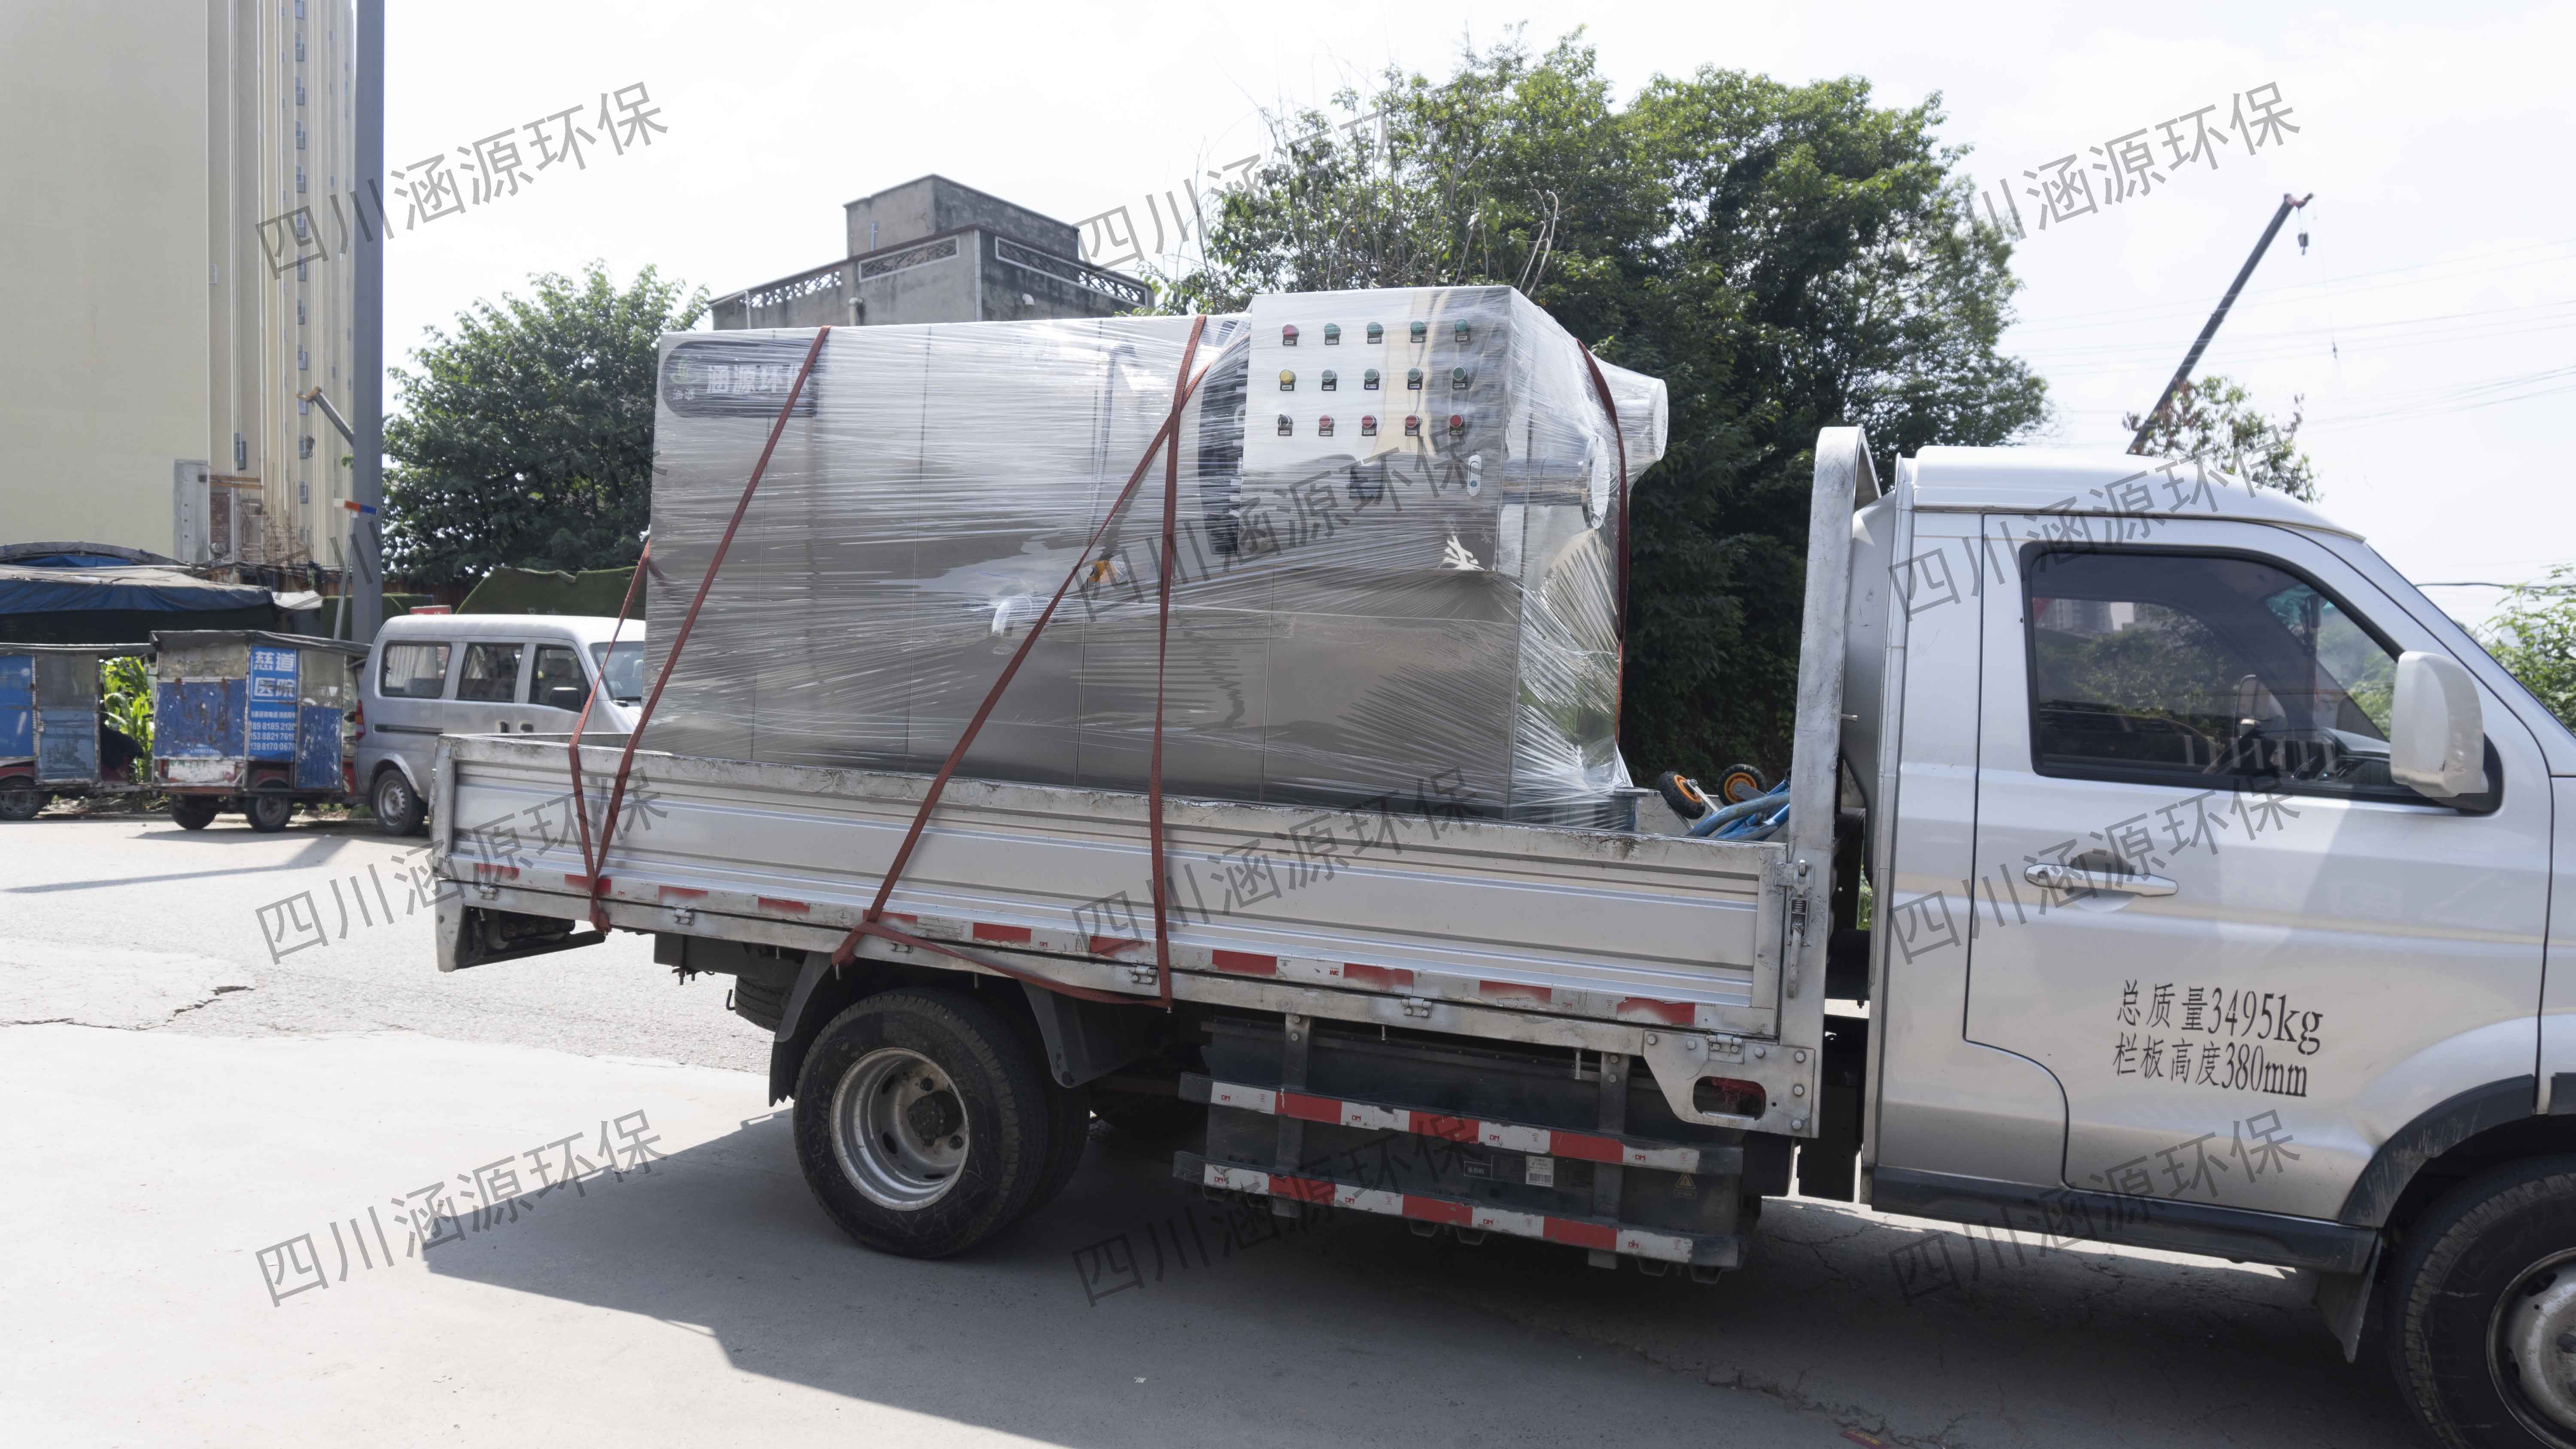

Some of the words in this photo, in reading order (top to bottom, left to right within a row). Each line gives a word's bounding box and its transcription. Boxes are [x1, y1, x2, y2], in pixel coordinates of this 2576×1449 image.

[253, 651, 295, 672] 慈道
[253, 677, 295, 697] 医院
[2117, 979, 2324, 1055] 总质量3495kg
[2112, 1031, 2307, 1098] 栏板高度380mm
